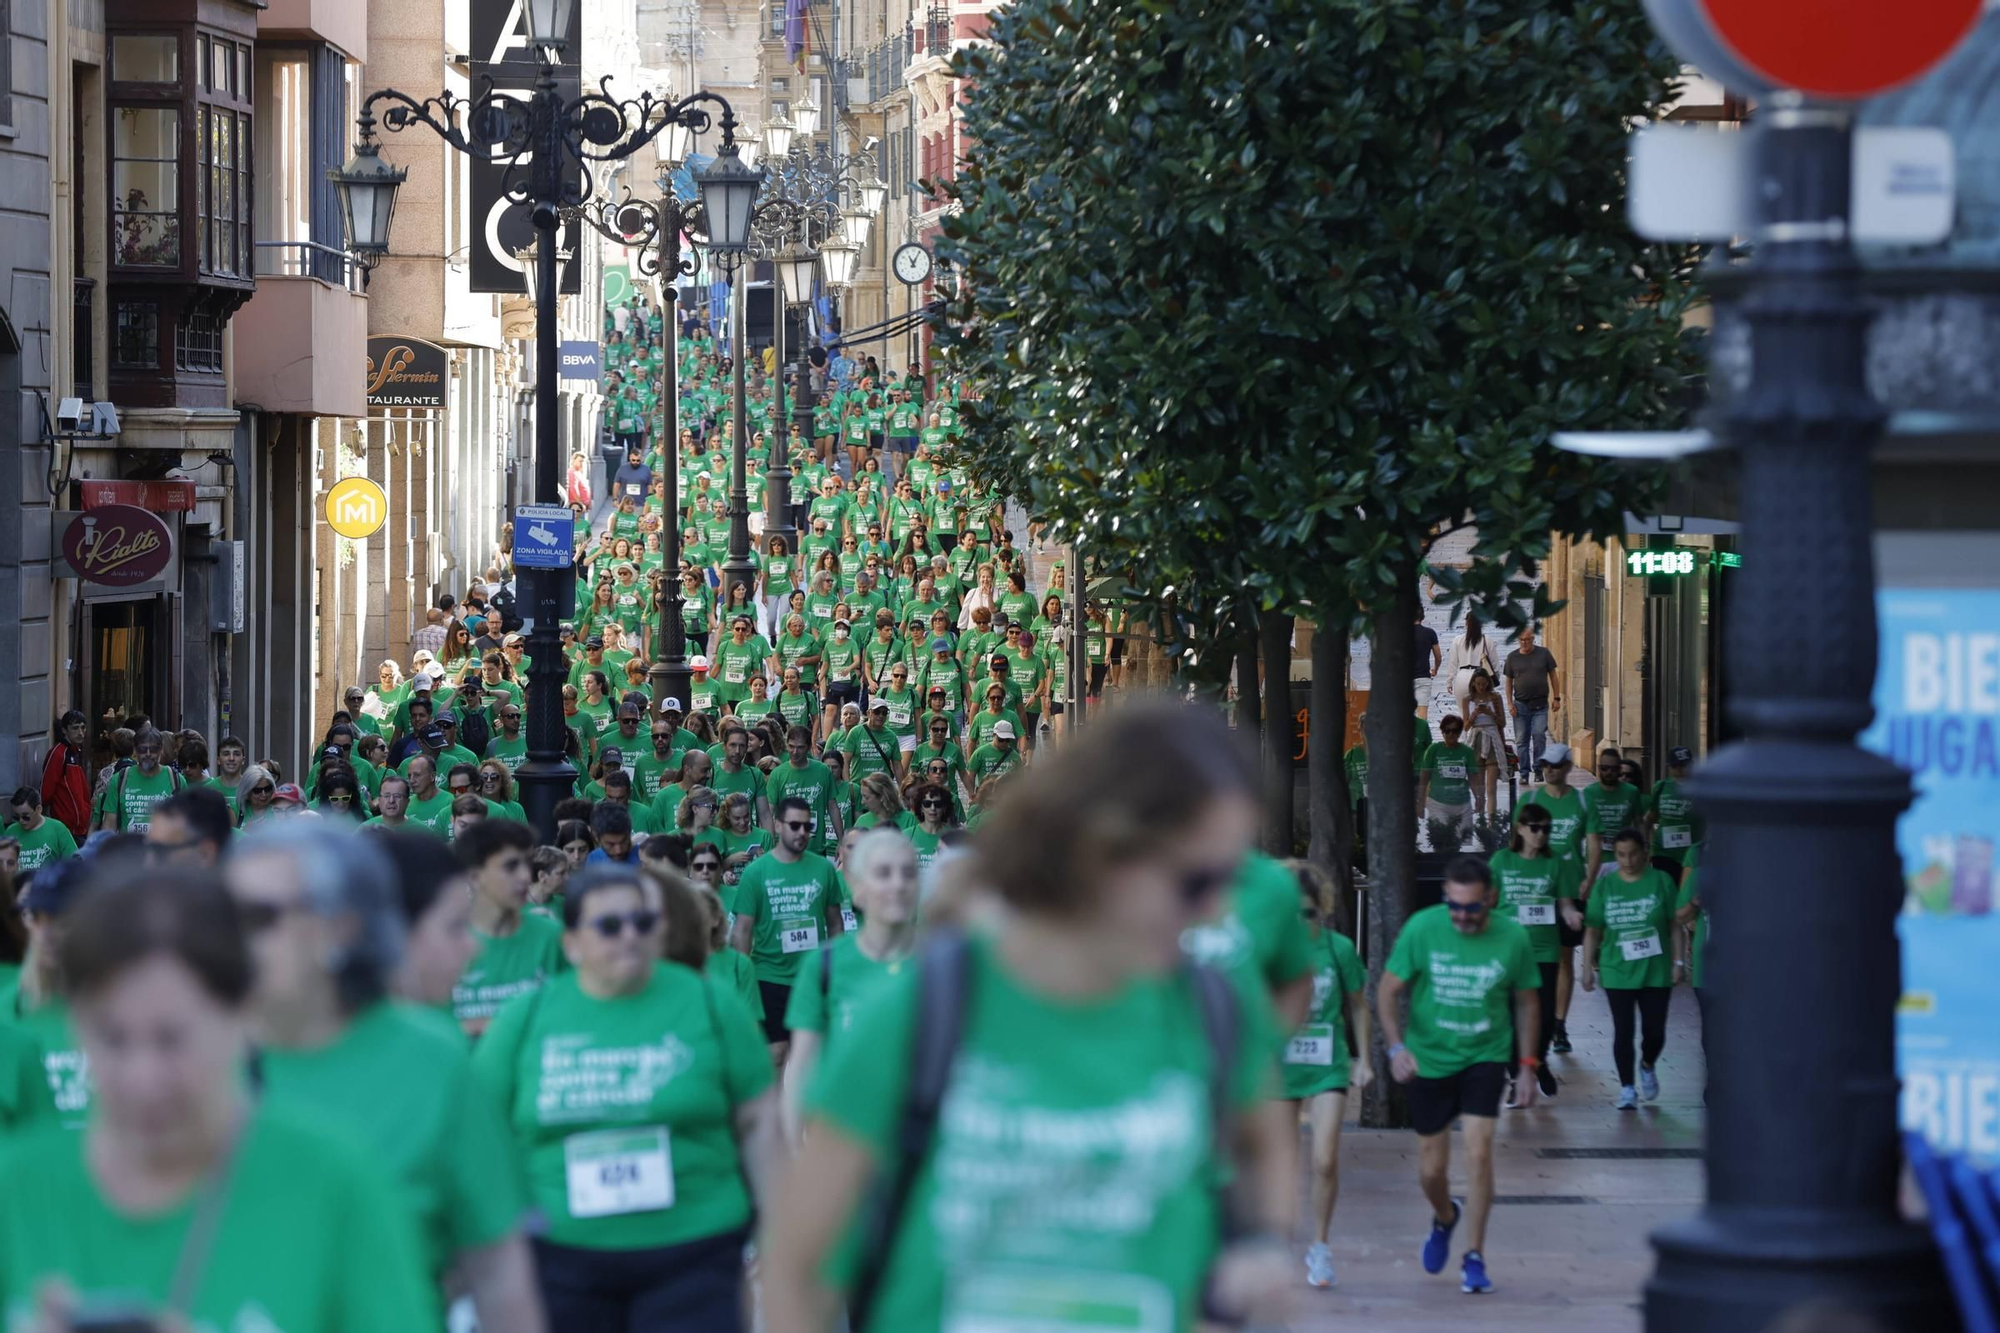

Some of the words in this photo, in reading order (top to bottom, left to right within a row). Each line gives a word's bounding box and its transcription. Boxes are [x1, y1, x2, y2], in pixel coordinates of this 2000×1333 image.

[563, 355, 596, 365] BBVA
[76, 526, 161, 574] Rialto
[516, 546, 536, 554] ZONA
[537, 548, 569, 556] VIGILADA
[125, 793, 135, 801] En
[767, 886, 781, 897] En
[769, 895, 798, 905] contra
[780, 903, 811, 913] cáncer
[790, 931, 808, 942] 584
